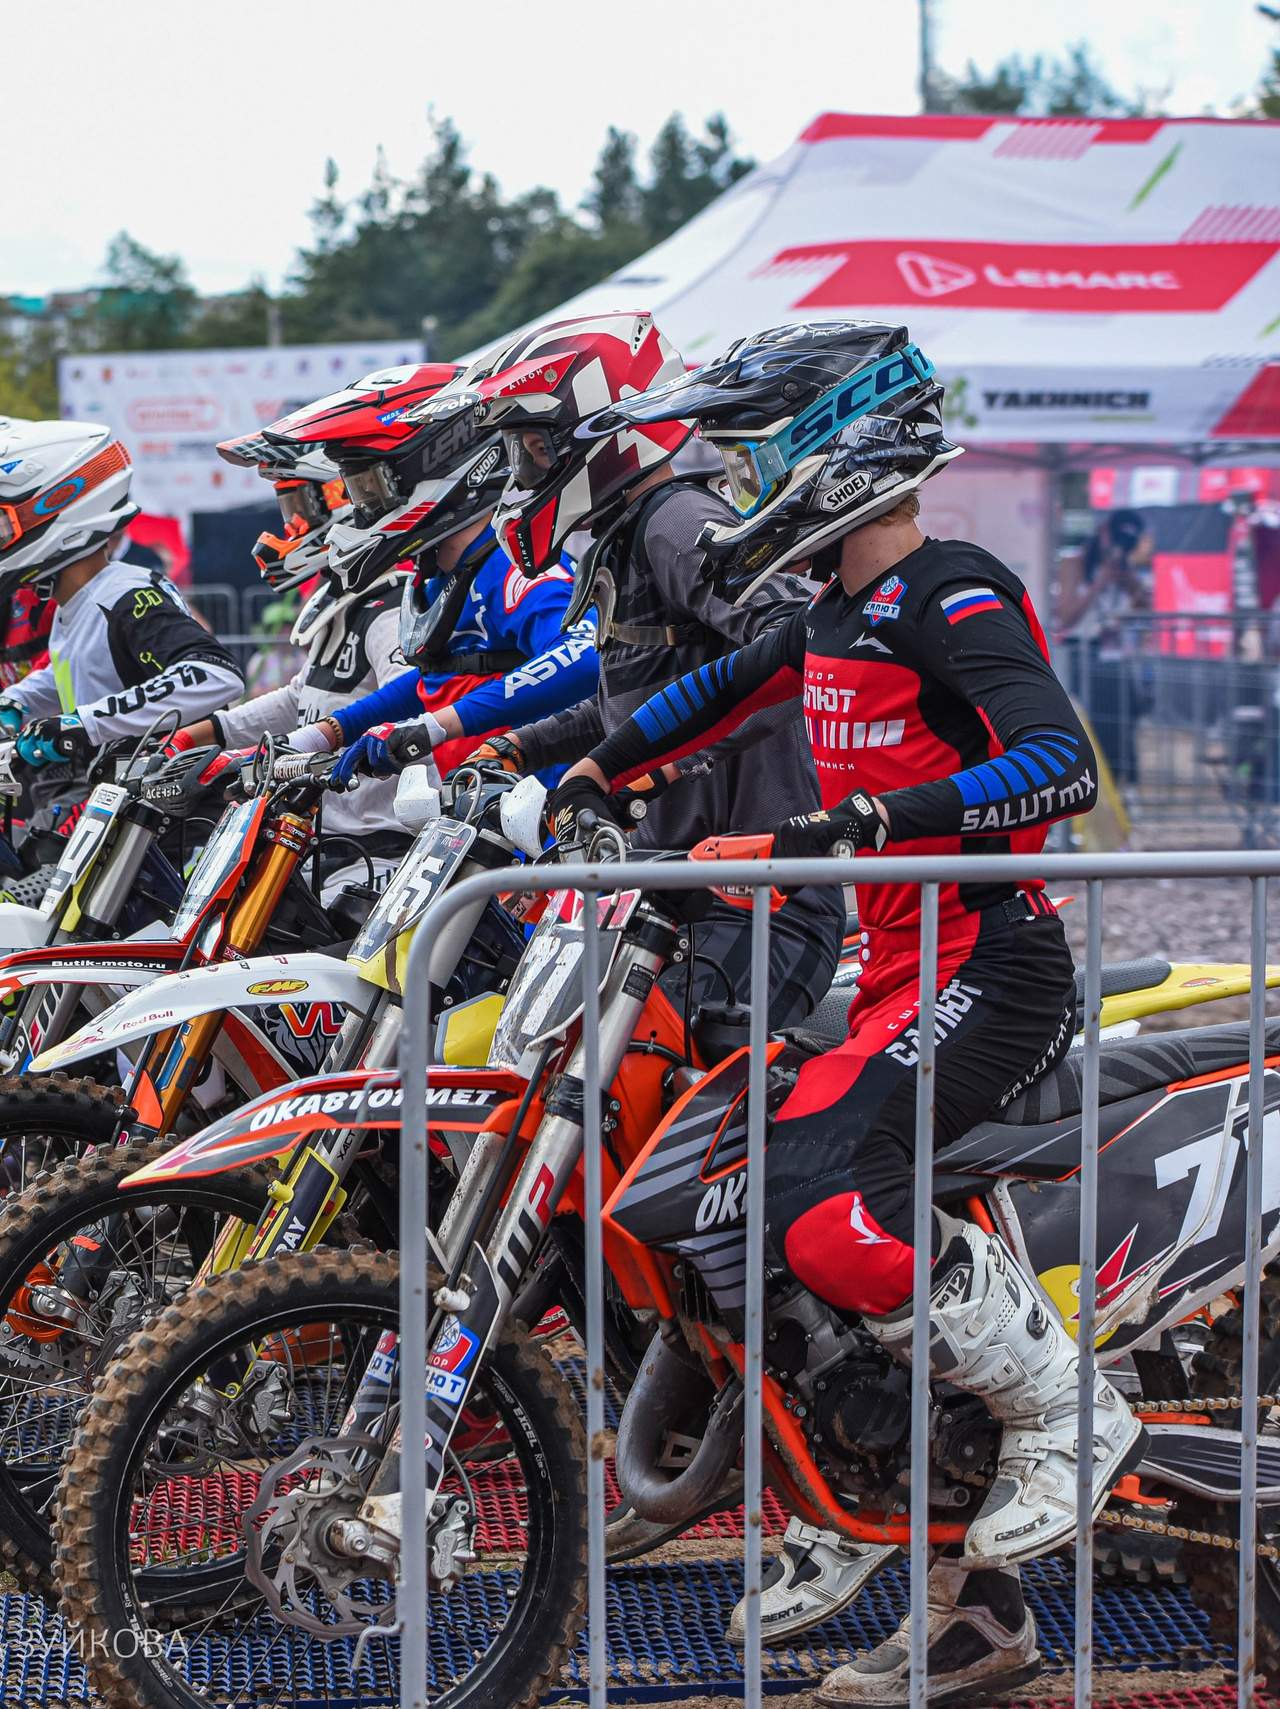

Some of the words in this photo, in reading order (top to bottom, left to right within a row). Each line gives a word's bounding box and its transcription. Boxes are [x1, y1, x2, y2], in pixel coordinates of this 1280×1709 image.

[509, 368, 543, 391] AIROH
[413, 394, 472, 417] Airoh
[469, 450, 498, 485] SHOEI
[826, 474, 867, 508] SHOEI
[51, 960, 166, 969] Butik-moto.ru
[249, 980, 307, 995] FMF
[122, 1016, 147, 1031] Red
[149, 1010, 174, 1021] Bull
[336, 1130, 356, 1161] XACT
[512, 1407, 540, 1449] EXCEL
[994, 1512, 1051, 1542] GAERNE
[760, 1601, 805, 1625] AERNE
